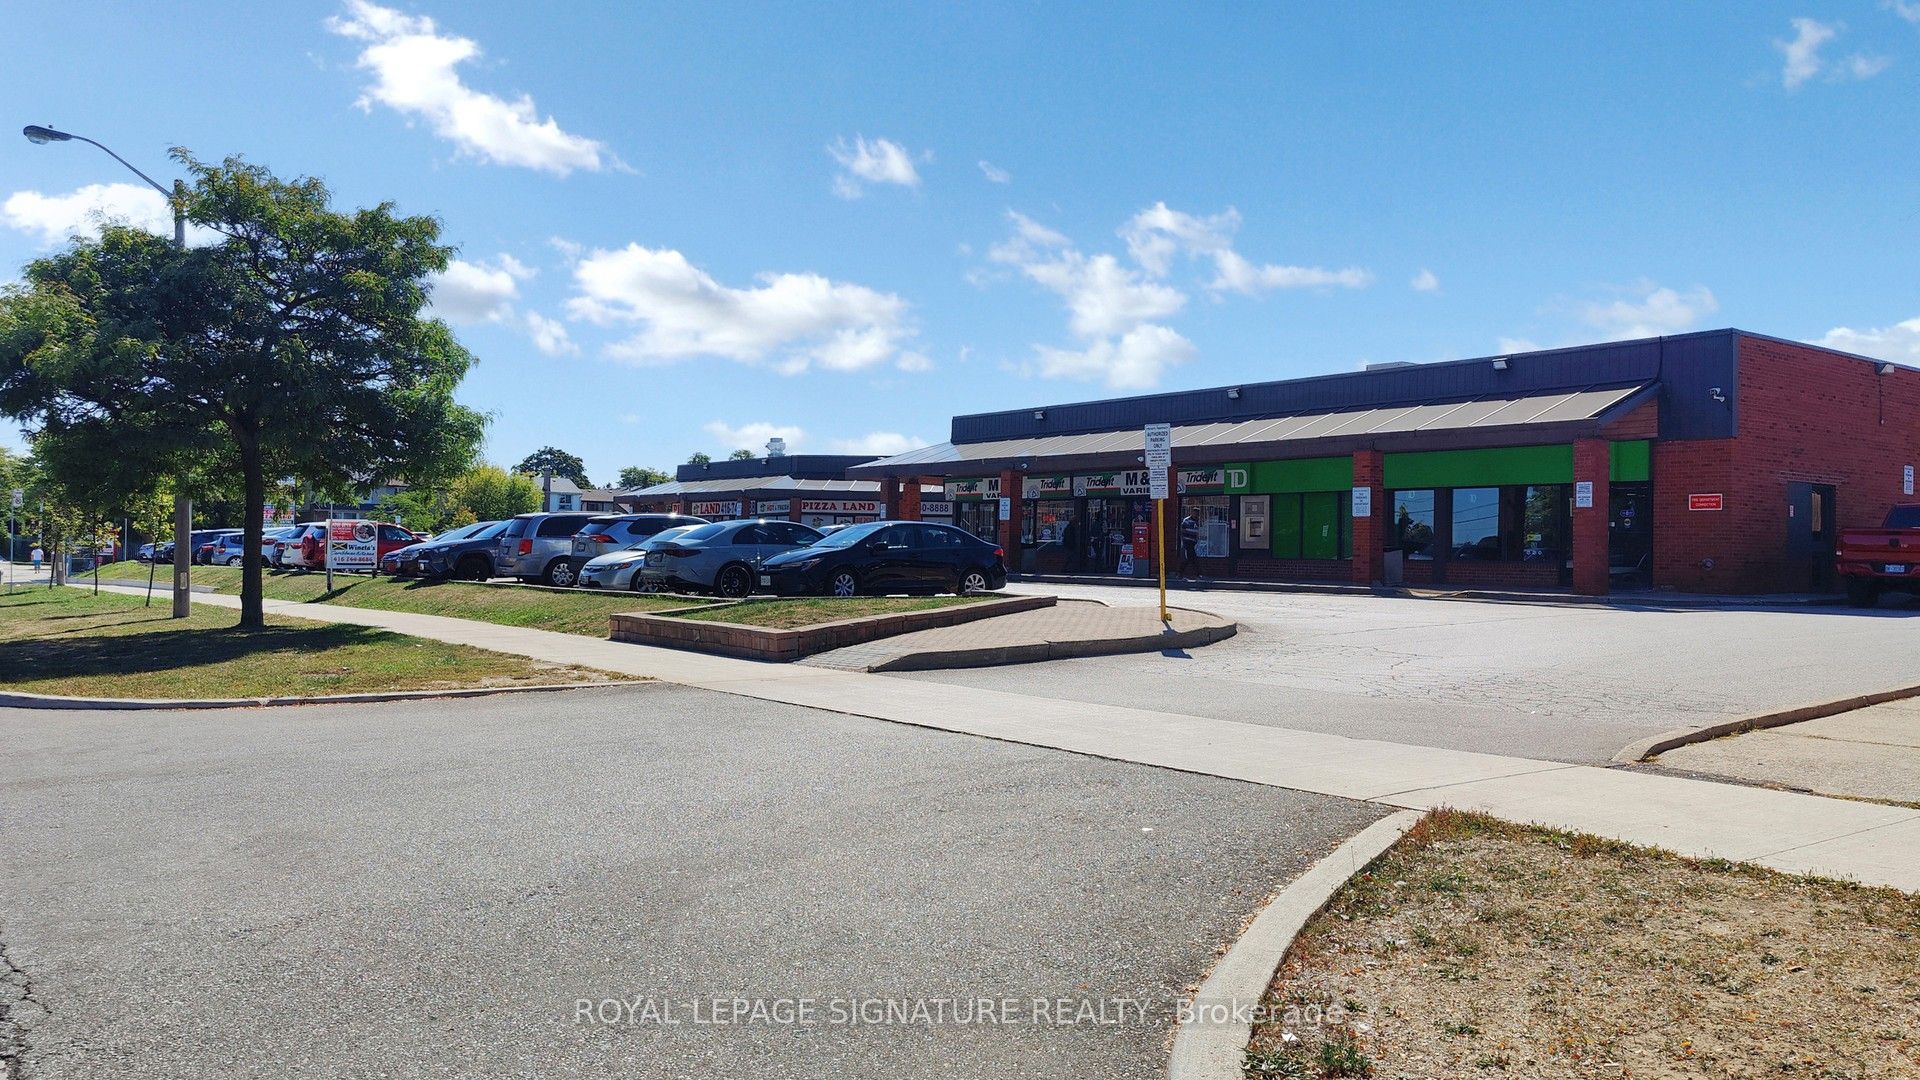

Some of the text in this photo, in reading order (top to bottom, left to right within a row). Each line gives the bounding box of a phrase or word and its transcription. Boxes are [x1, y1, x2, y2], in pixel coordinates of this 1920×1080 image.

[1086, 475, 1115, 489] Trident
[1125, 472, 1138, 486] M
[1186, 472, 1218, 484] Trident
[1226, 469, 1248, 488] TD
[956, 484, 978, 493] Trident
[988, 479, 999, 491] M
[1040, 479, 1065, 490] Trident
[700, 502, 720, 515] LAND
[802, 502, 837, 510] PIZZA
[842, 502, 876, 511] LAND
